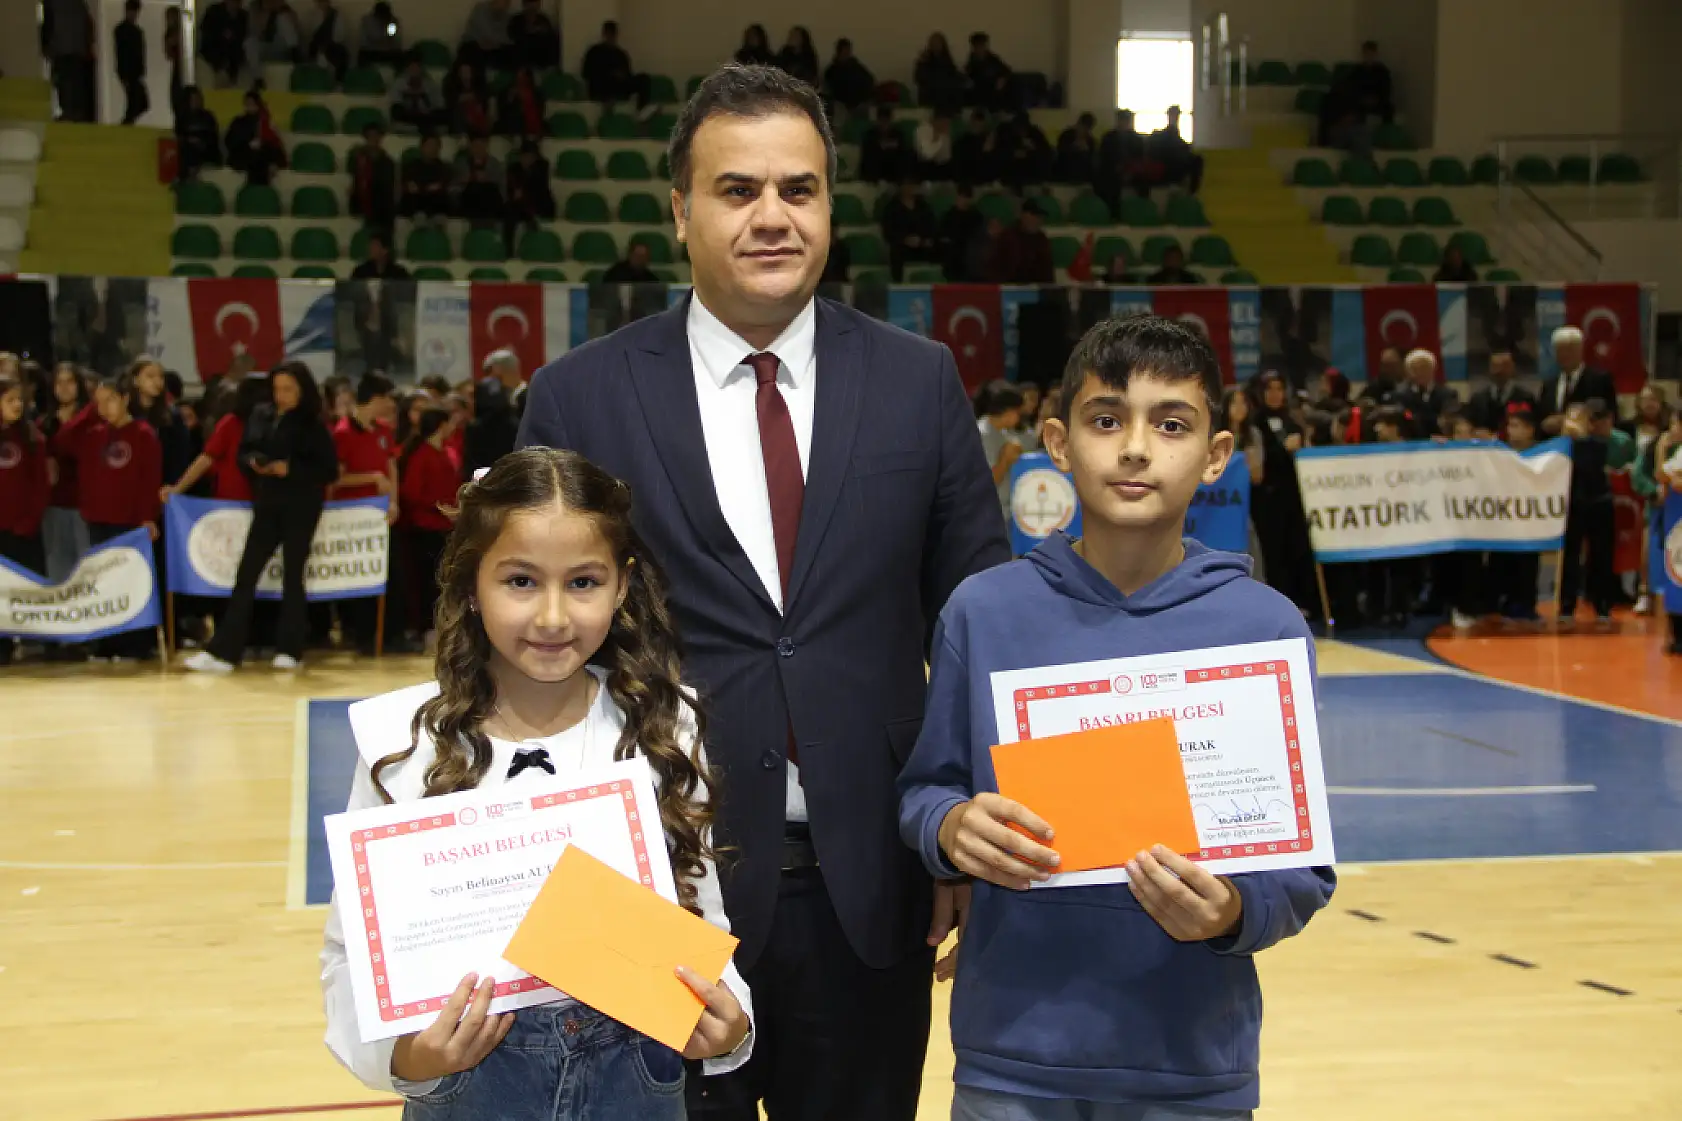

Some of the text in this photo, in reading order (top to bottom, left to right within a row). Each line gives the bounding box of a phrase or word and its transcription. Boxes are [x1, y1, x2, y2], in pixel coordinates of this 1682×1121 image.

[1306, 494, 1566, 530] ATATÜRK İLKOKULU
[423, 824, 573, 867] BAŞARI BELGESİ
